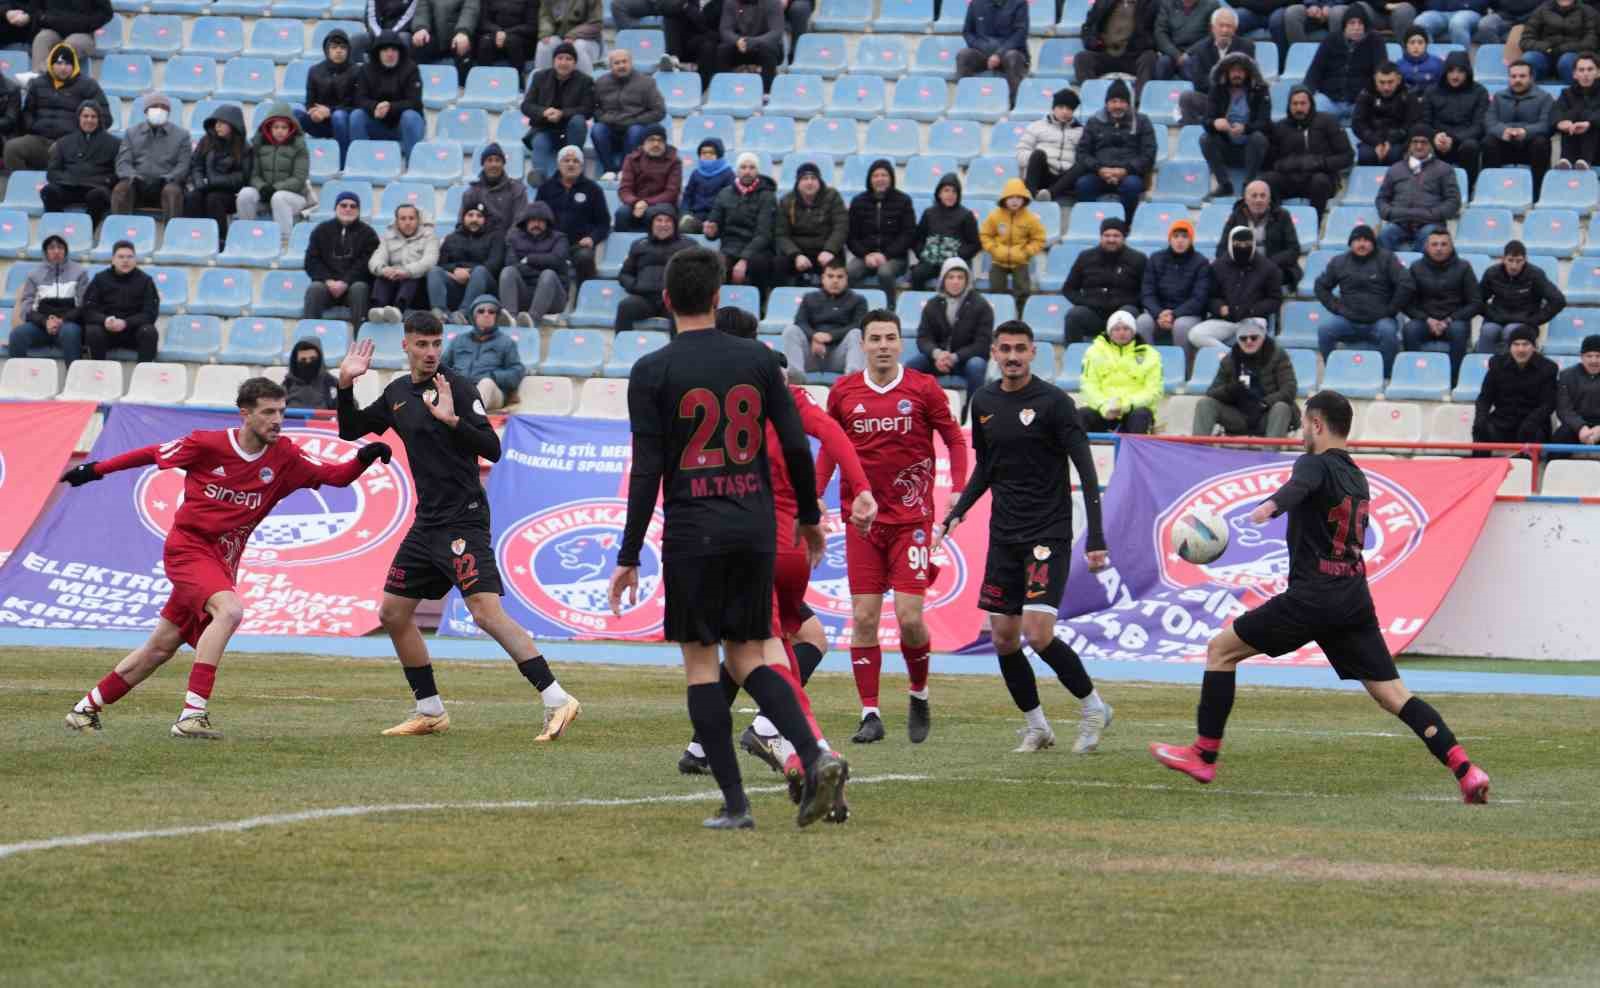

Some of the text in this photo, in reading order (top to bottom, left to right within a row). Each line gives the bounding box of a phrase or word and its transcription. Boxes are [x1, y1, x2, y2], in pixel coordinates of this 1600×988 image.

[679, 384, 763, 470] 28
[853, 415, 912, 434] sinerji
[506, 448, 574, 471] KIRIKKALE
[204, 483, 262, 510] sinerji
[453, 553, 478, 580] 12
[907, 546, 928, 570] 90
